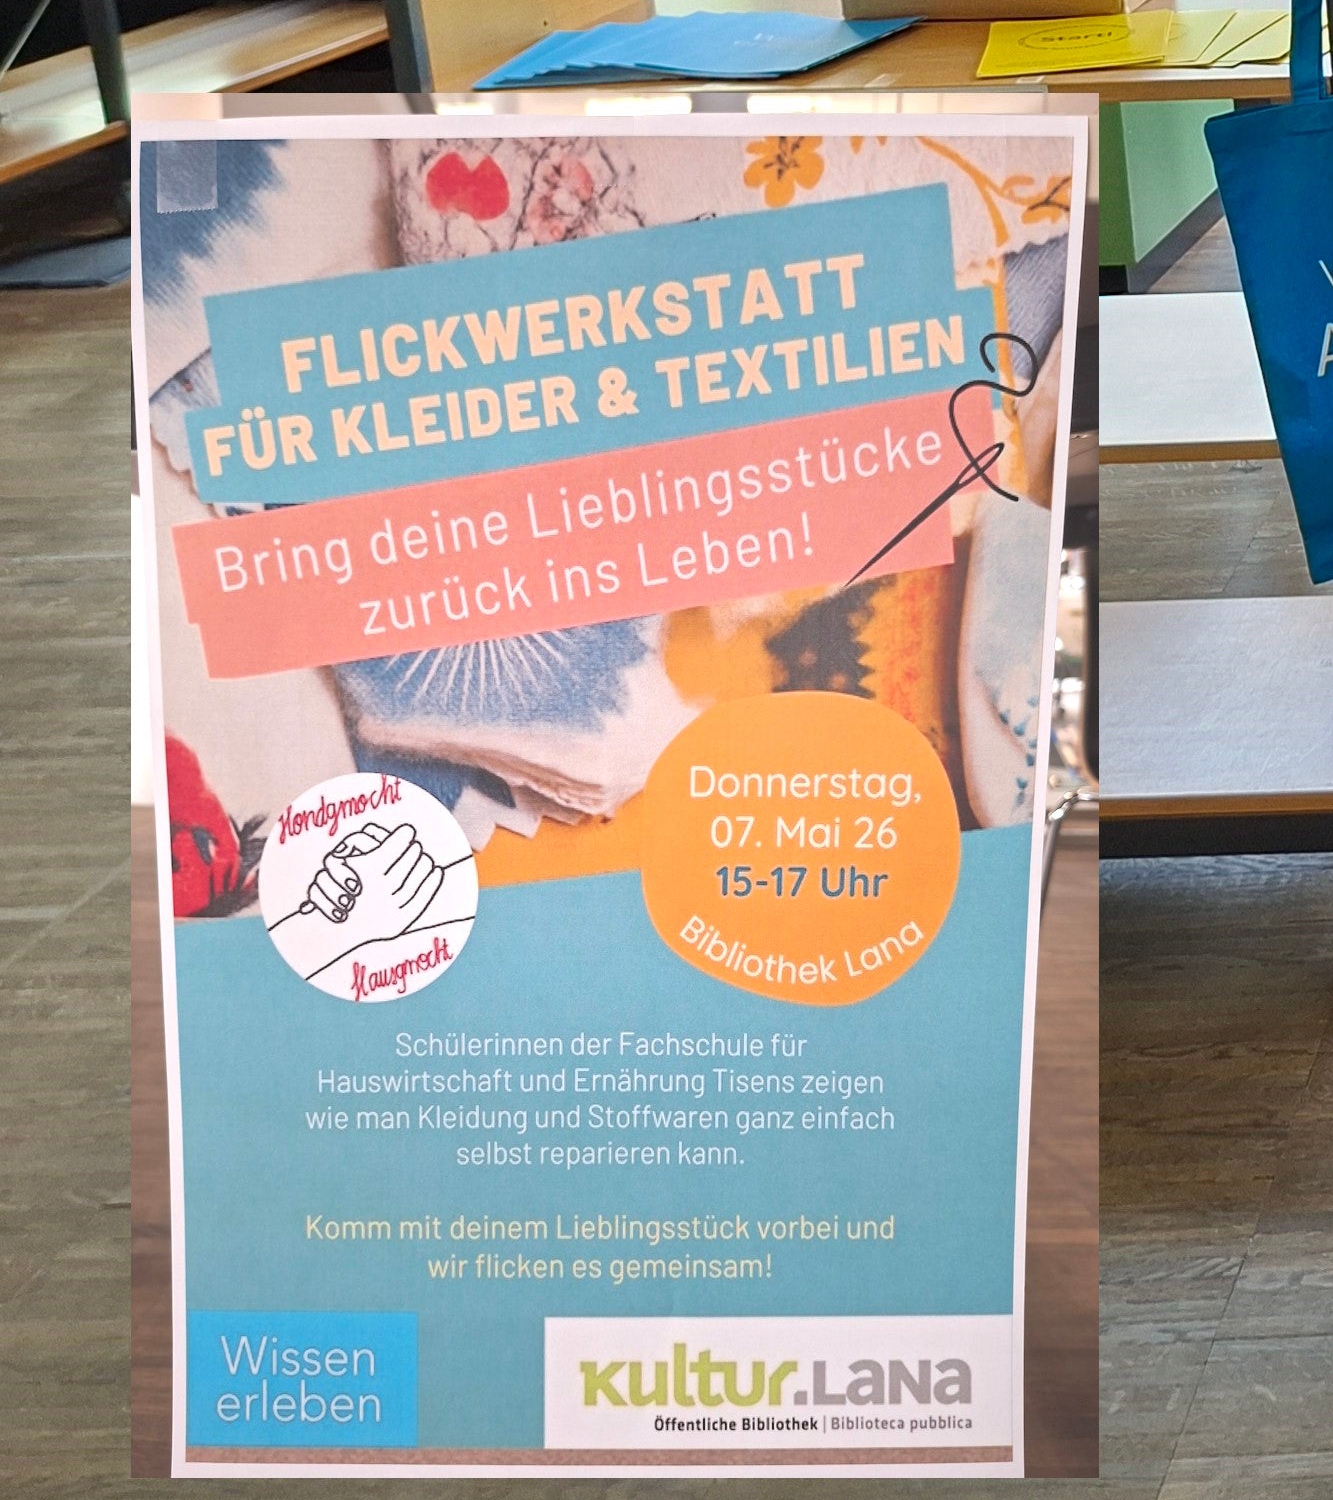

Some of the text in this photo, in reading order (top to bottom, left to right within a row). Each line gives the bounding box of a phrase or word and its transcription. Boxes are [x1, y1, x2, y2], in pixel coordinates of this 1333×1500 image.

[281, 253, 865, 394] FLICKWERKSTATT
[203, 315, 965, 477] FÜR KLEIDER & TEXTILIEN
[214, 426, 942, 593] Bring deine Lieblingsstücke
[359, 511, 814, 635] zurück ins Leben!
[689, 765, 922, 808] Donnerstag,
[710, 815, 898, 848] 07. Mai 26
[716, 865, 889, 897] 15-17 Uhr
[678, 914, 925, 984] Bibliothek Lana
[395, 1031, 808, 1057] Schülerinnen der Fachschule für
[317, 1067, 884, 1100] Hauswirtschaft und Ernährung Tisens zeigen
[305, 1104, 895, 1135] wie man Kleidung und Stoffwaren ganz einfach
[456, 1141, 745, 1171] selbst reparieren kann.
[305, 1214, 896, 1247] Komm mit deinem Lieblingsstück vorbei und
[428, 1253, 773, 1286] wir flicken es gemeinsam!
[220, 1334, 376, 1377] Wissen
[216, 1378, 382, 1423] erleben
[653, 1414, 973, 1433] Öffentliche Bibliothek Biblioteca pubblica
